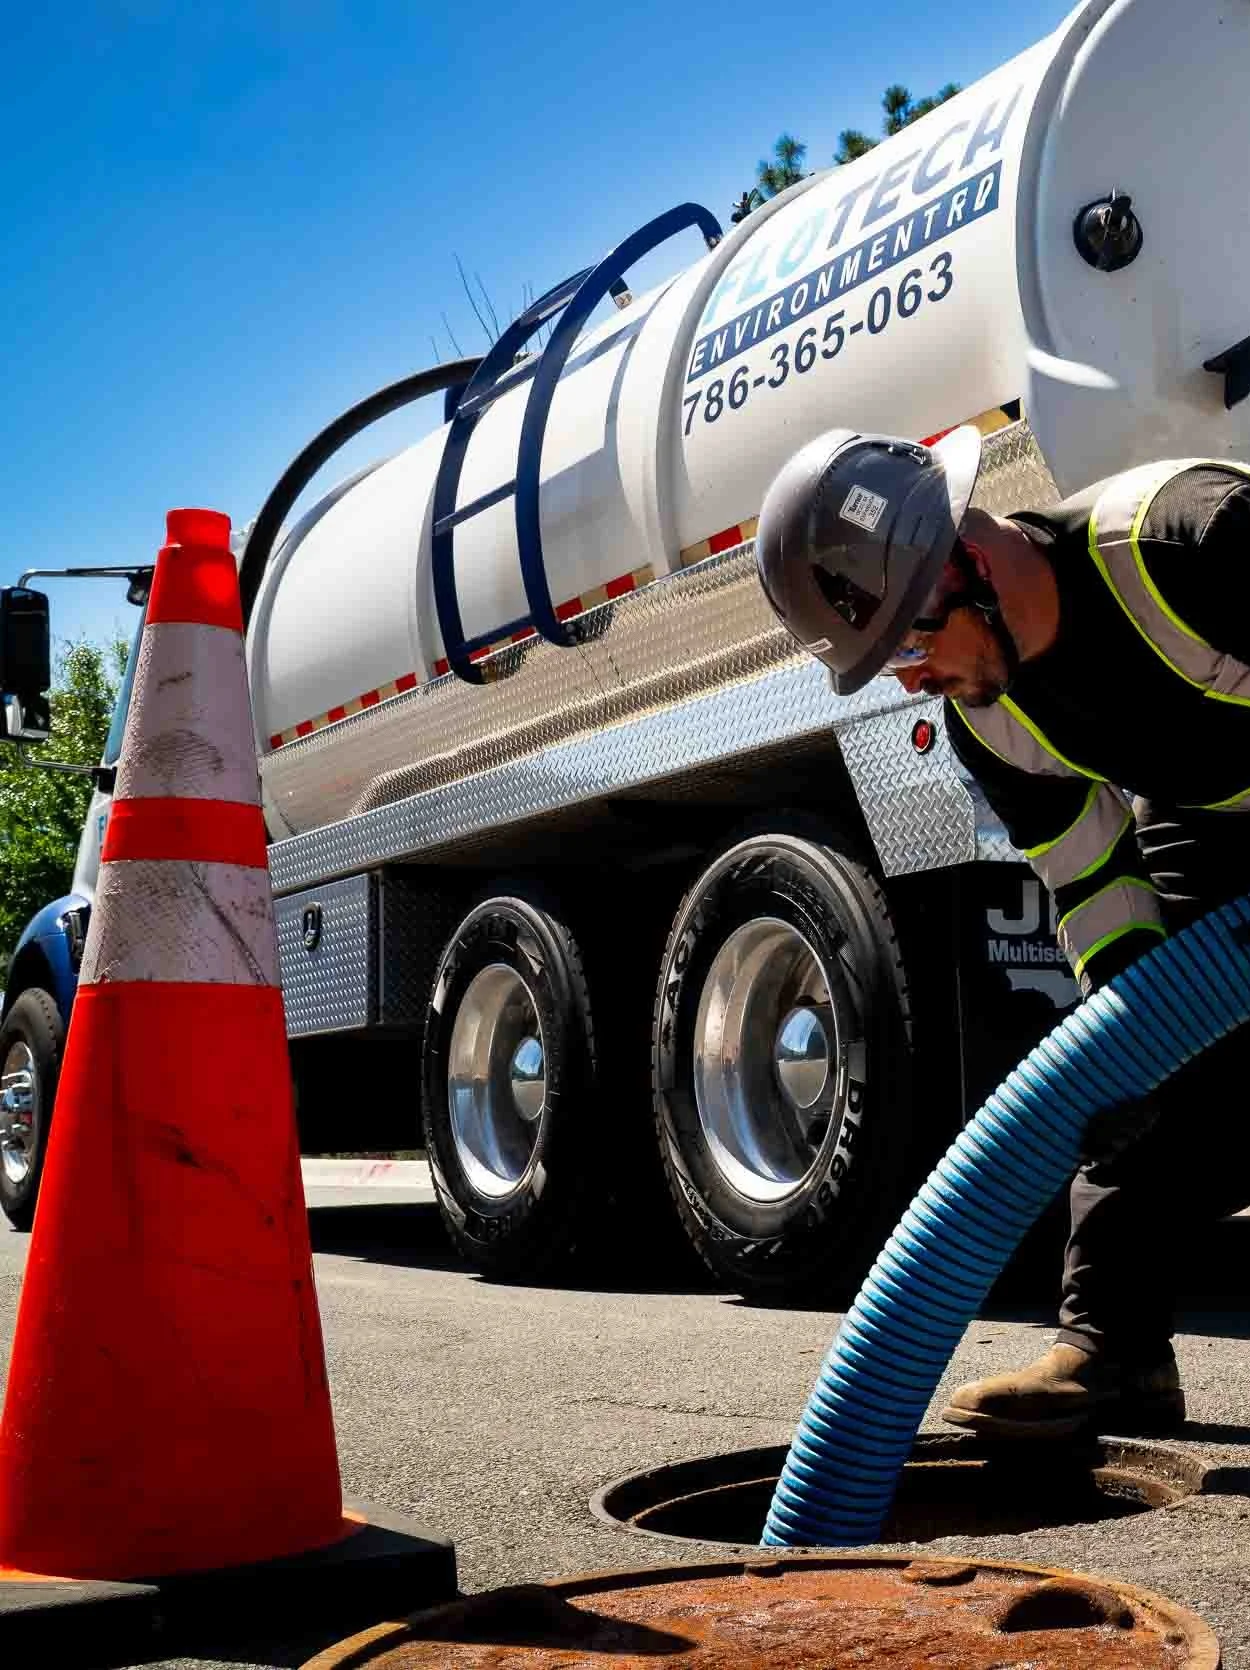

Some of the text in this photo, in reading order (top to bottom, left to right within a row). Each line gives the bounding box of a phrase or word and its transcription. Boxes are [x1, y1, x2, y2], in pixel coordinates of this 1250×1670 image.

[702, 84, 1024, 325] FLOTECH
[683, 251, 953, 436] 786-365-063
[987, 940, 1067, 963] Multise
